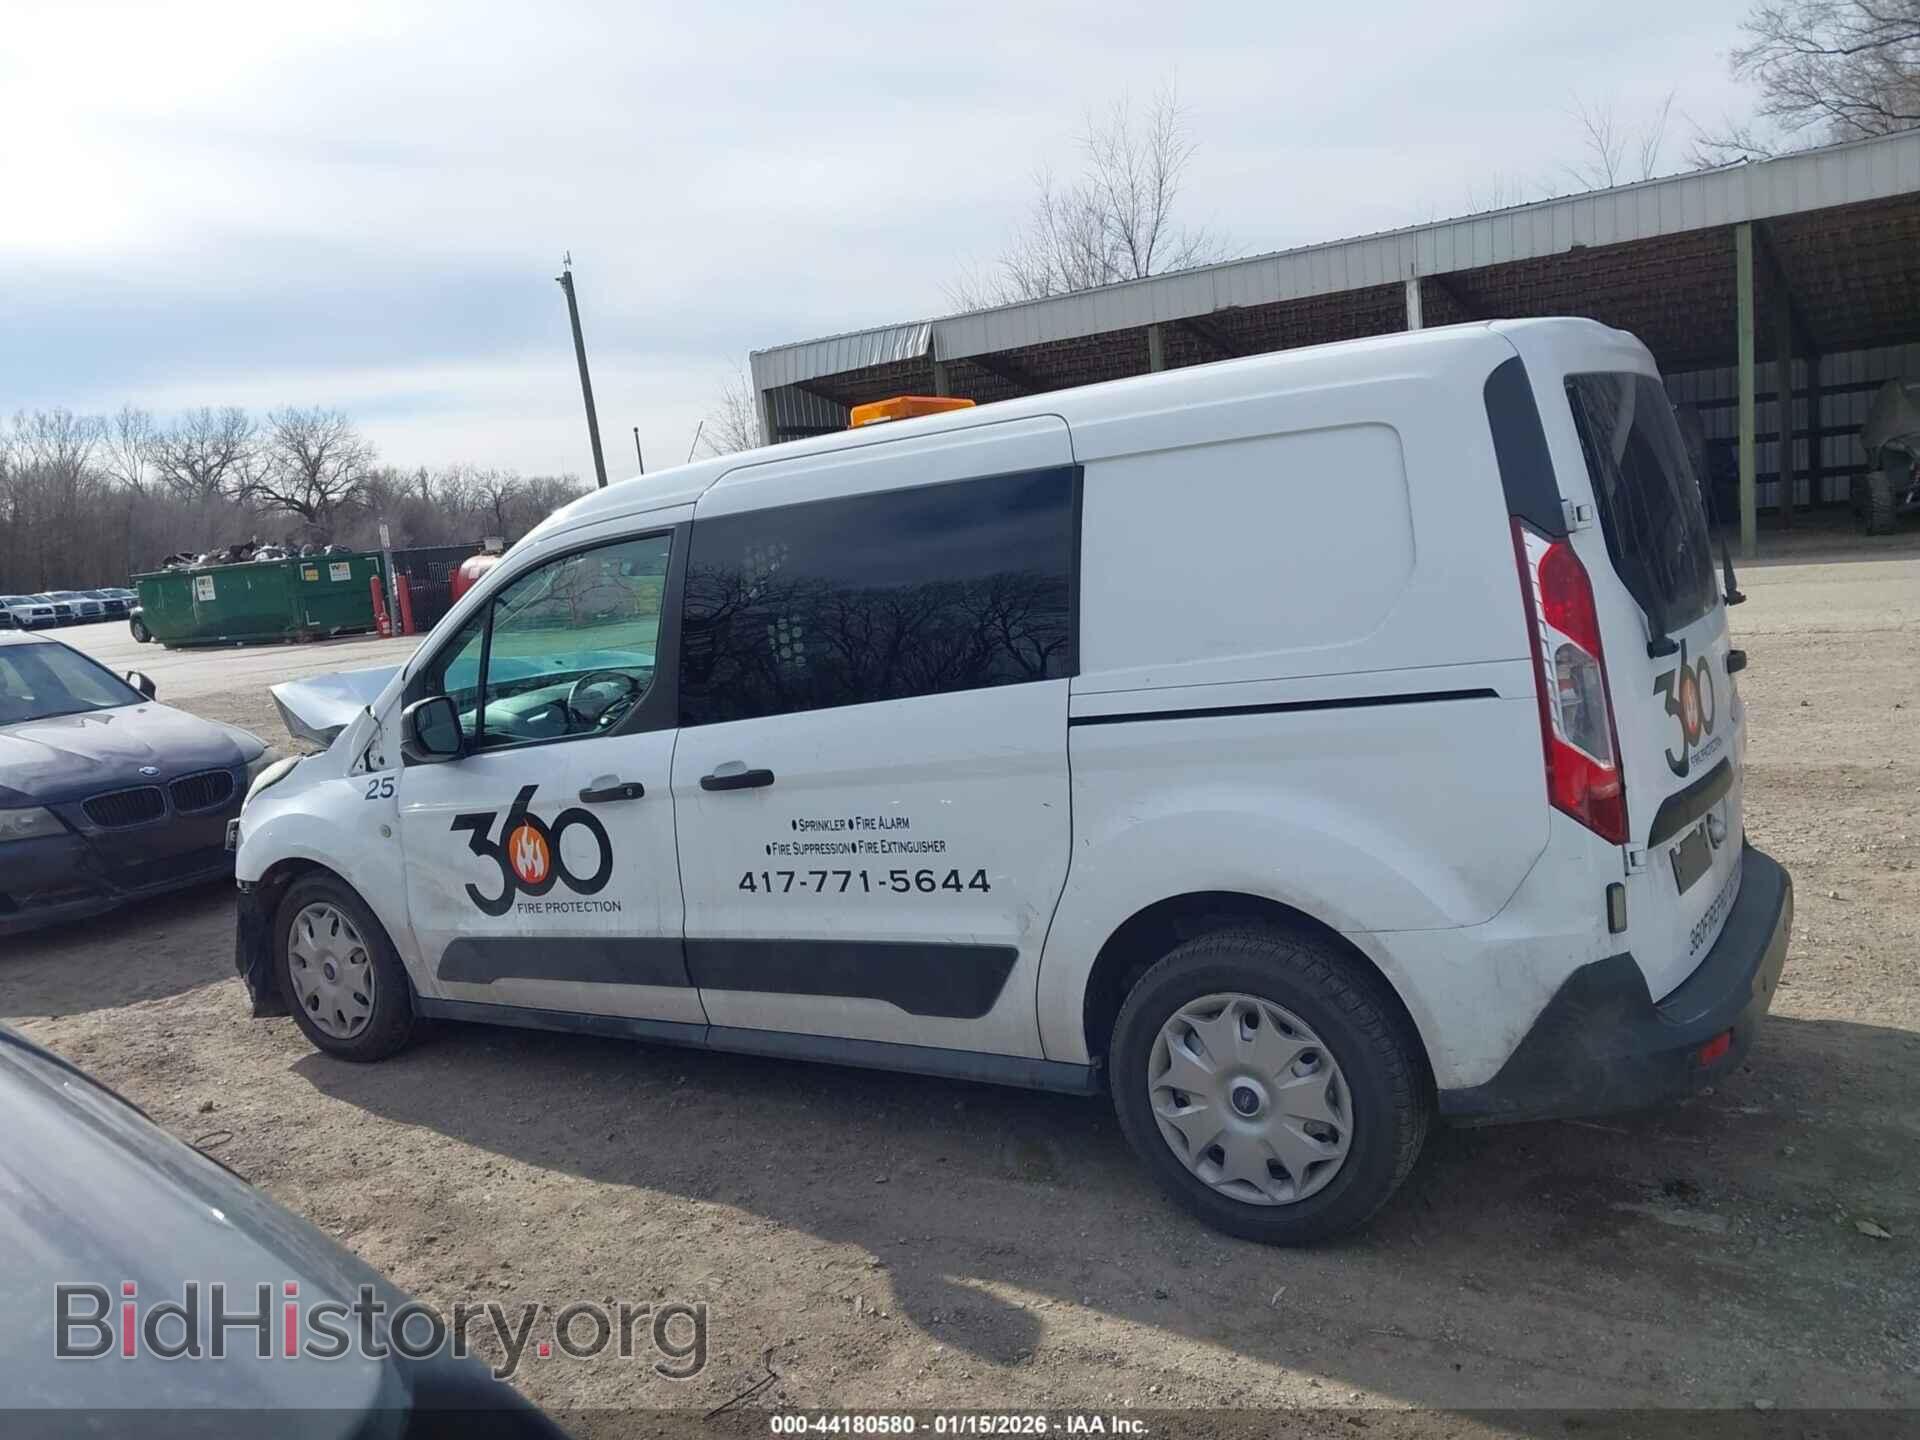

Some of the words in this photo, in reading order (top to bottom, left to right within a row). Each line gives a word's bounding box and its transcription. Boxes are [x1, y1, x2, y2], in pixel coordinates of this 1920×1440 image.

[1653, 638, 1714, 777] 360
[365, 776, 394, 800] 25
[450, 784, 613, 917] 360
[738, 869, 991, 893] 417-771-5644
[517, 902, 543, 913] FIRE
[545, 901, 622, 913] PROTECTION
